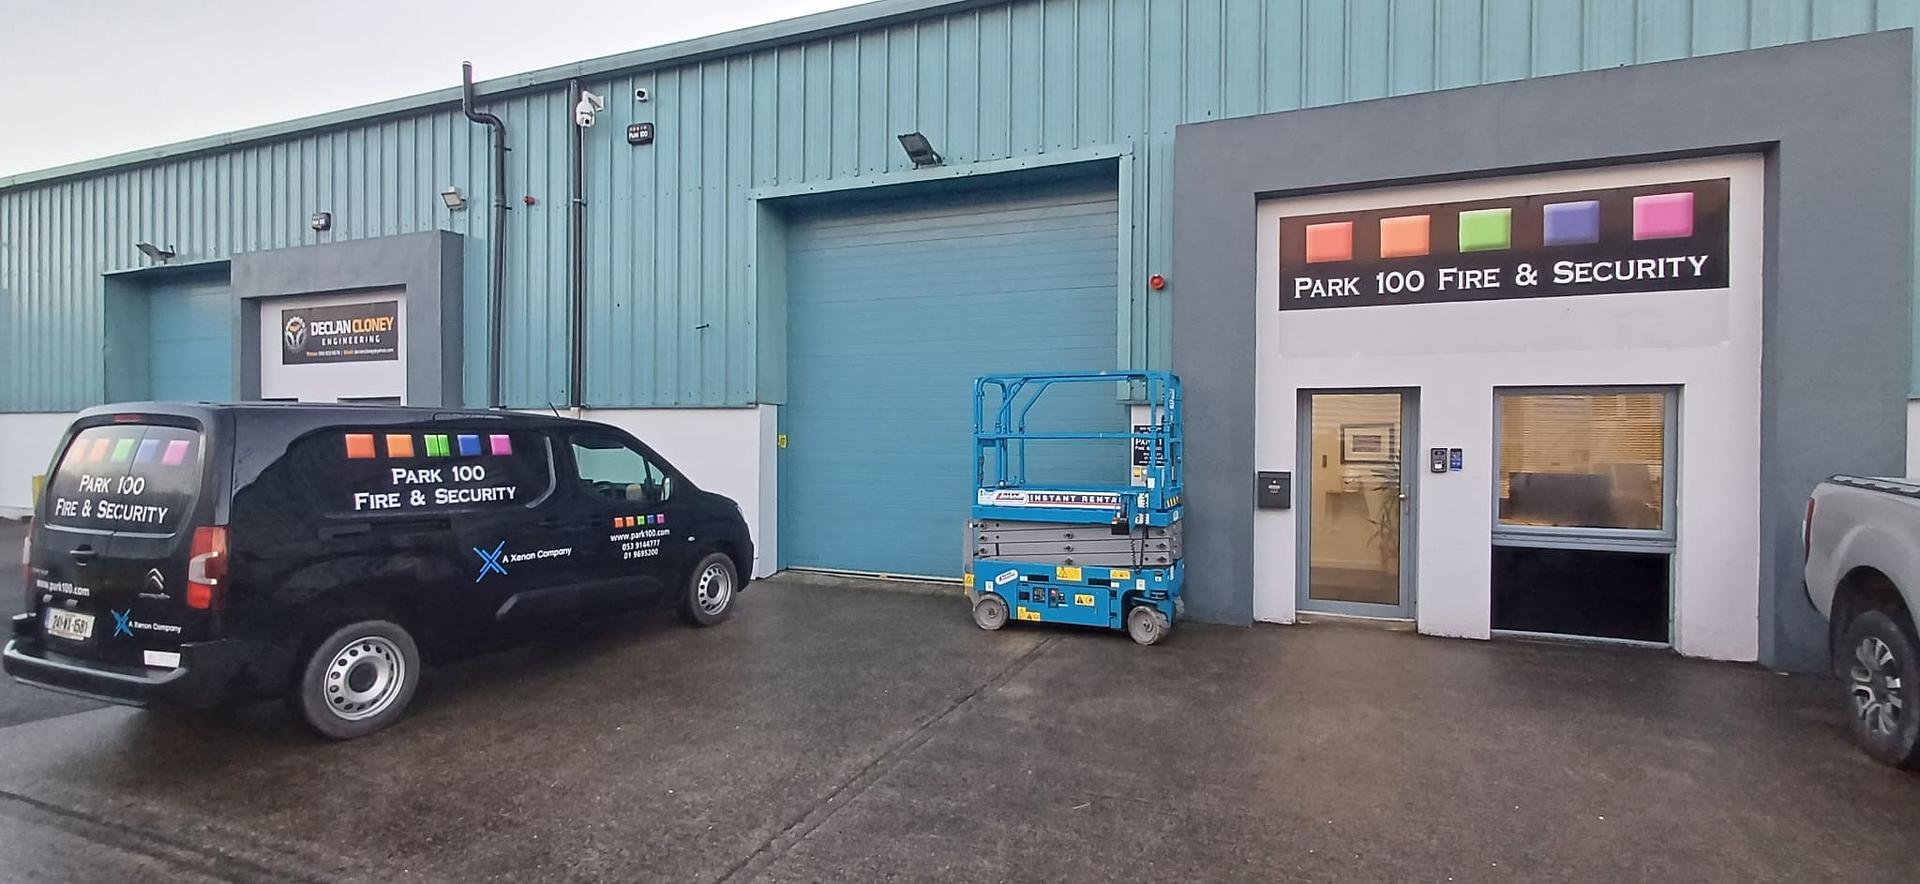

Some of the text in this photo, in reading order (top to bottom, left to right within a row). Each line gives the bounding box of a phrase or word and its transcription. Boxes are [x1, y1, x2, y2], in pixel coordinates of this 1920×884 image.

[1294, 255, 1710, 299] PARK 100 FIRE & SECURITY
[310, 316, 394, 336] DECLAN CLONEY
[322, 334, 381, 346] ENGINEERING
[391, 465, 485, 485] PARK 100
[79, 474, 145, 495] PARK 100
[354, 486, 516, 510] FIRE & SECURITY
[1030, 494, 1075, 502] INSTANT
[55, 498, 168, 524] FIRE & SECURITY
[610, 528, 670, 542] www.park100.com
[622, 542, 634, 551] 053
[502, 547, 572, 564] A Xenon Company
[623, 551, 631, 560] 01
[36, 579, 90, 597] www.park100.com
[128, 620, 133, 628] A
[153, 622, 182, 634] Company
